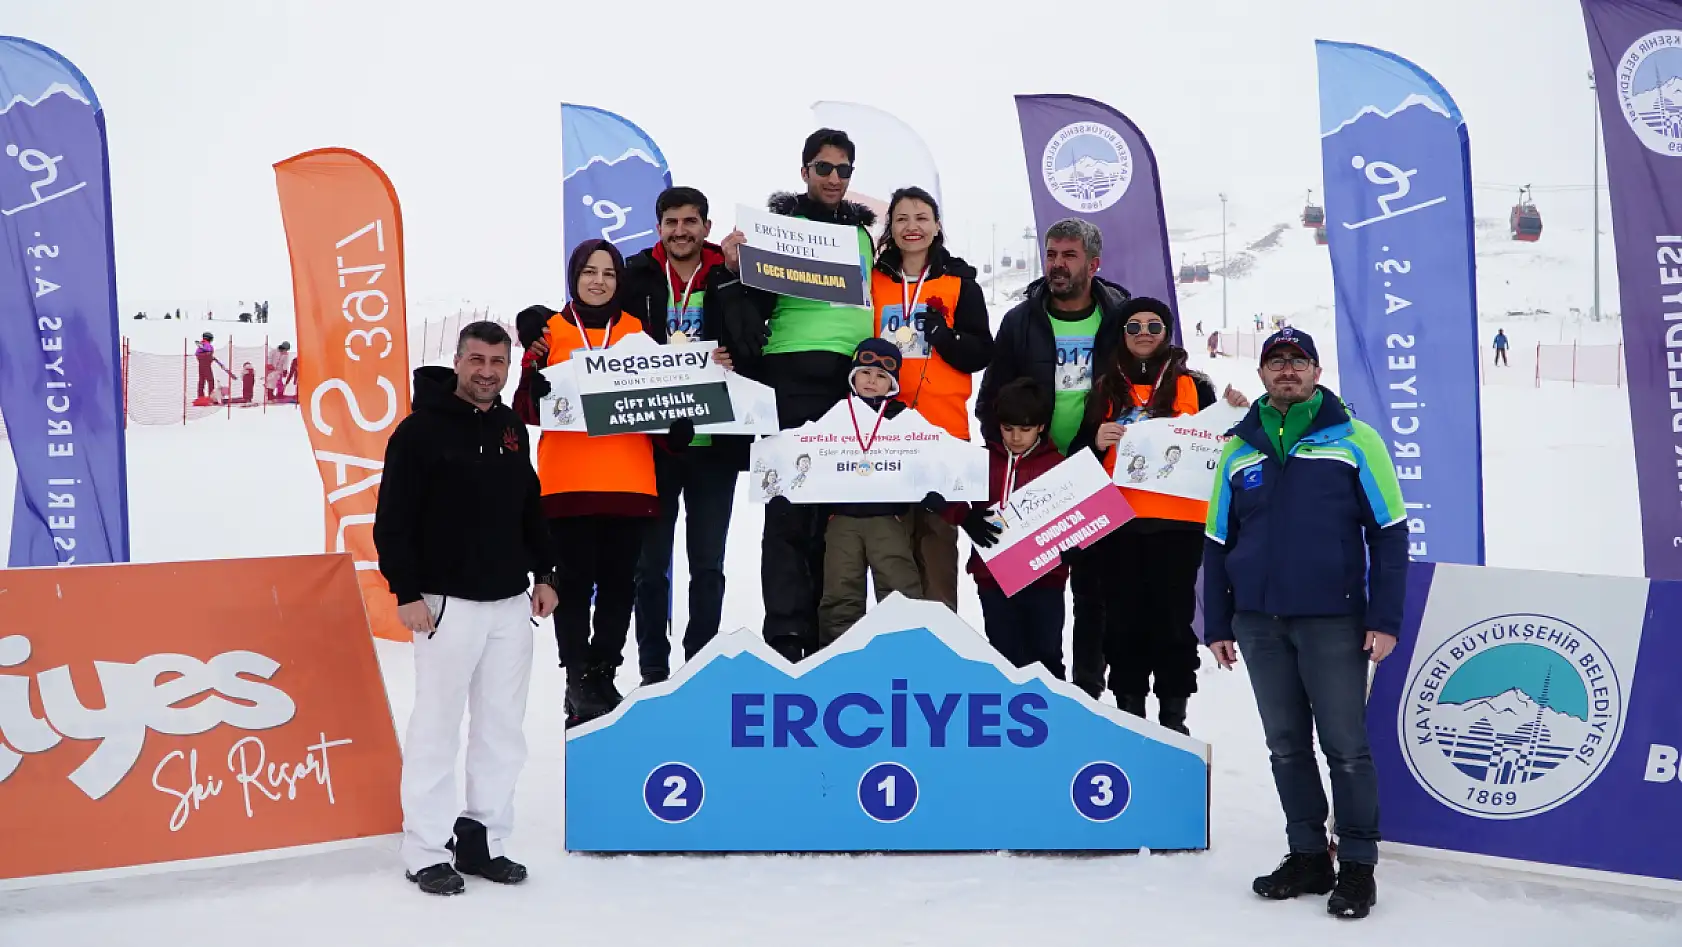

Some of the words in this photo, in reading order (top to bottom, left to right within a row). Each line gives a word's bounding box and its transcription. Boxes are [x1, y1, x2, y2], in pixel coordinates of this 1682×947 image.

[755, 223, 804, 242] ERCİYES
[808, 234, 840, 247] HILL
[776, 241, 819, 258] HOTEL
[756, 262, 762, 273] 1
[763, 263, 785, 279] GECE
[786, 269, 846, 289] KONAKLAMA
[585, 351, 709, 375] Megasaray
[1056, 347, 1093, 366] 017
[614, 378, 645, 386] MOUNT
[609, 411, 655, 426] AKŞAM
[659, 403, 710, 420] YEMEĞİ
[614, 397, 644, 412] ÇİFT
[648, 392, 695, 408] KİŞİLİK
[837, 460, 901, 471] BİRCİSİ
[1206, 459, 1219, 470] Ü
[1035, 510, 1085, 547] GONDOL'DA
[1416, 659, 1451, 745] KAYSERİ
[1450, 623, 1581, 660] BÜYÜKŞEHİR
[1575, 653, 1612, 767] BELEDİYESİ
[0, 634, 296, 800] iyes
[731, 678, 1049, 749] ERCİYES
[1643, 743, 1682, 784] B
[151, 749, 223, 831] Ski
[227, 732, 353, 817] Resort
[663, 776, 687, 807] 2
[877, 776, 896, 807] 1
[1090, 776, 1114, 807] 3
[1467, 787, 1517, 806] 1869
